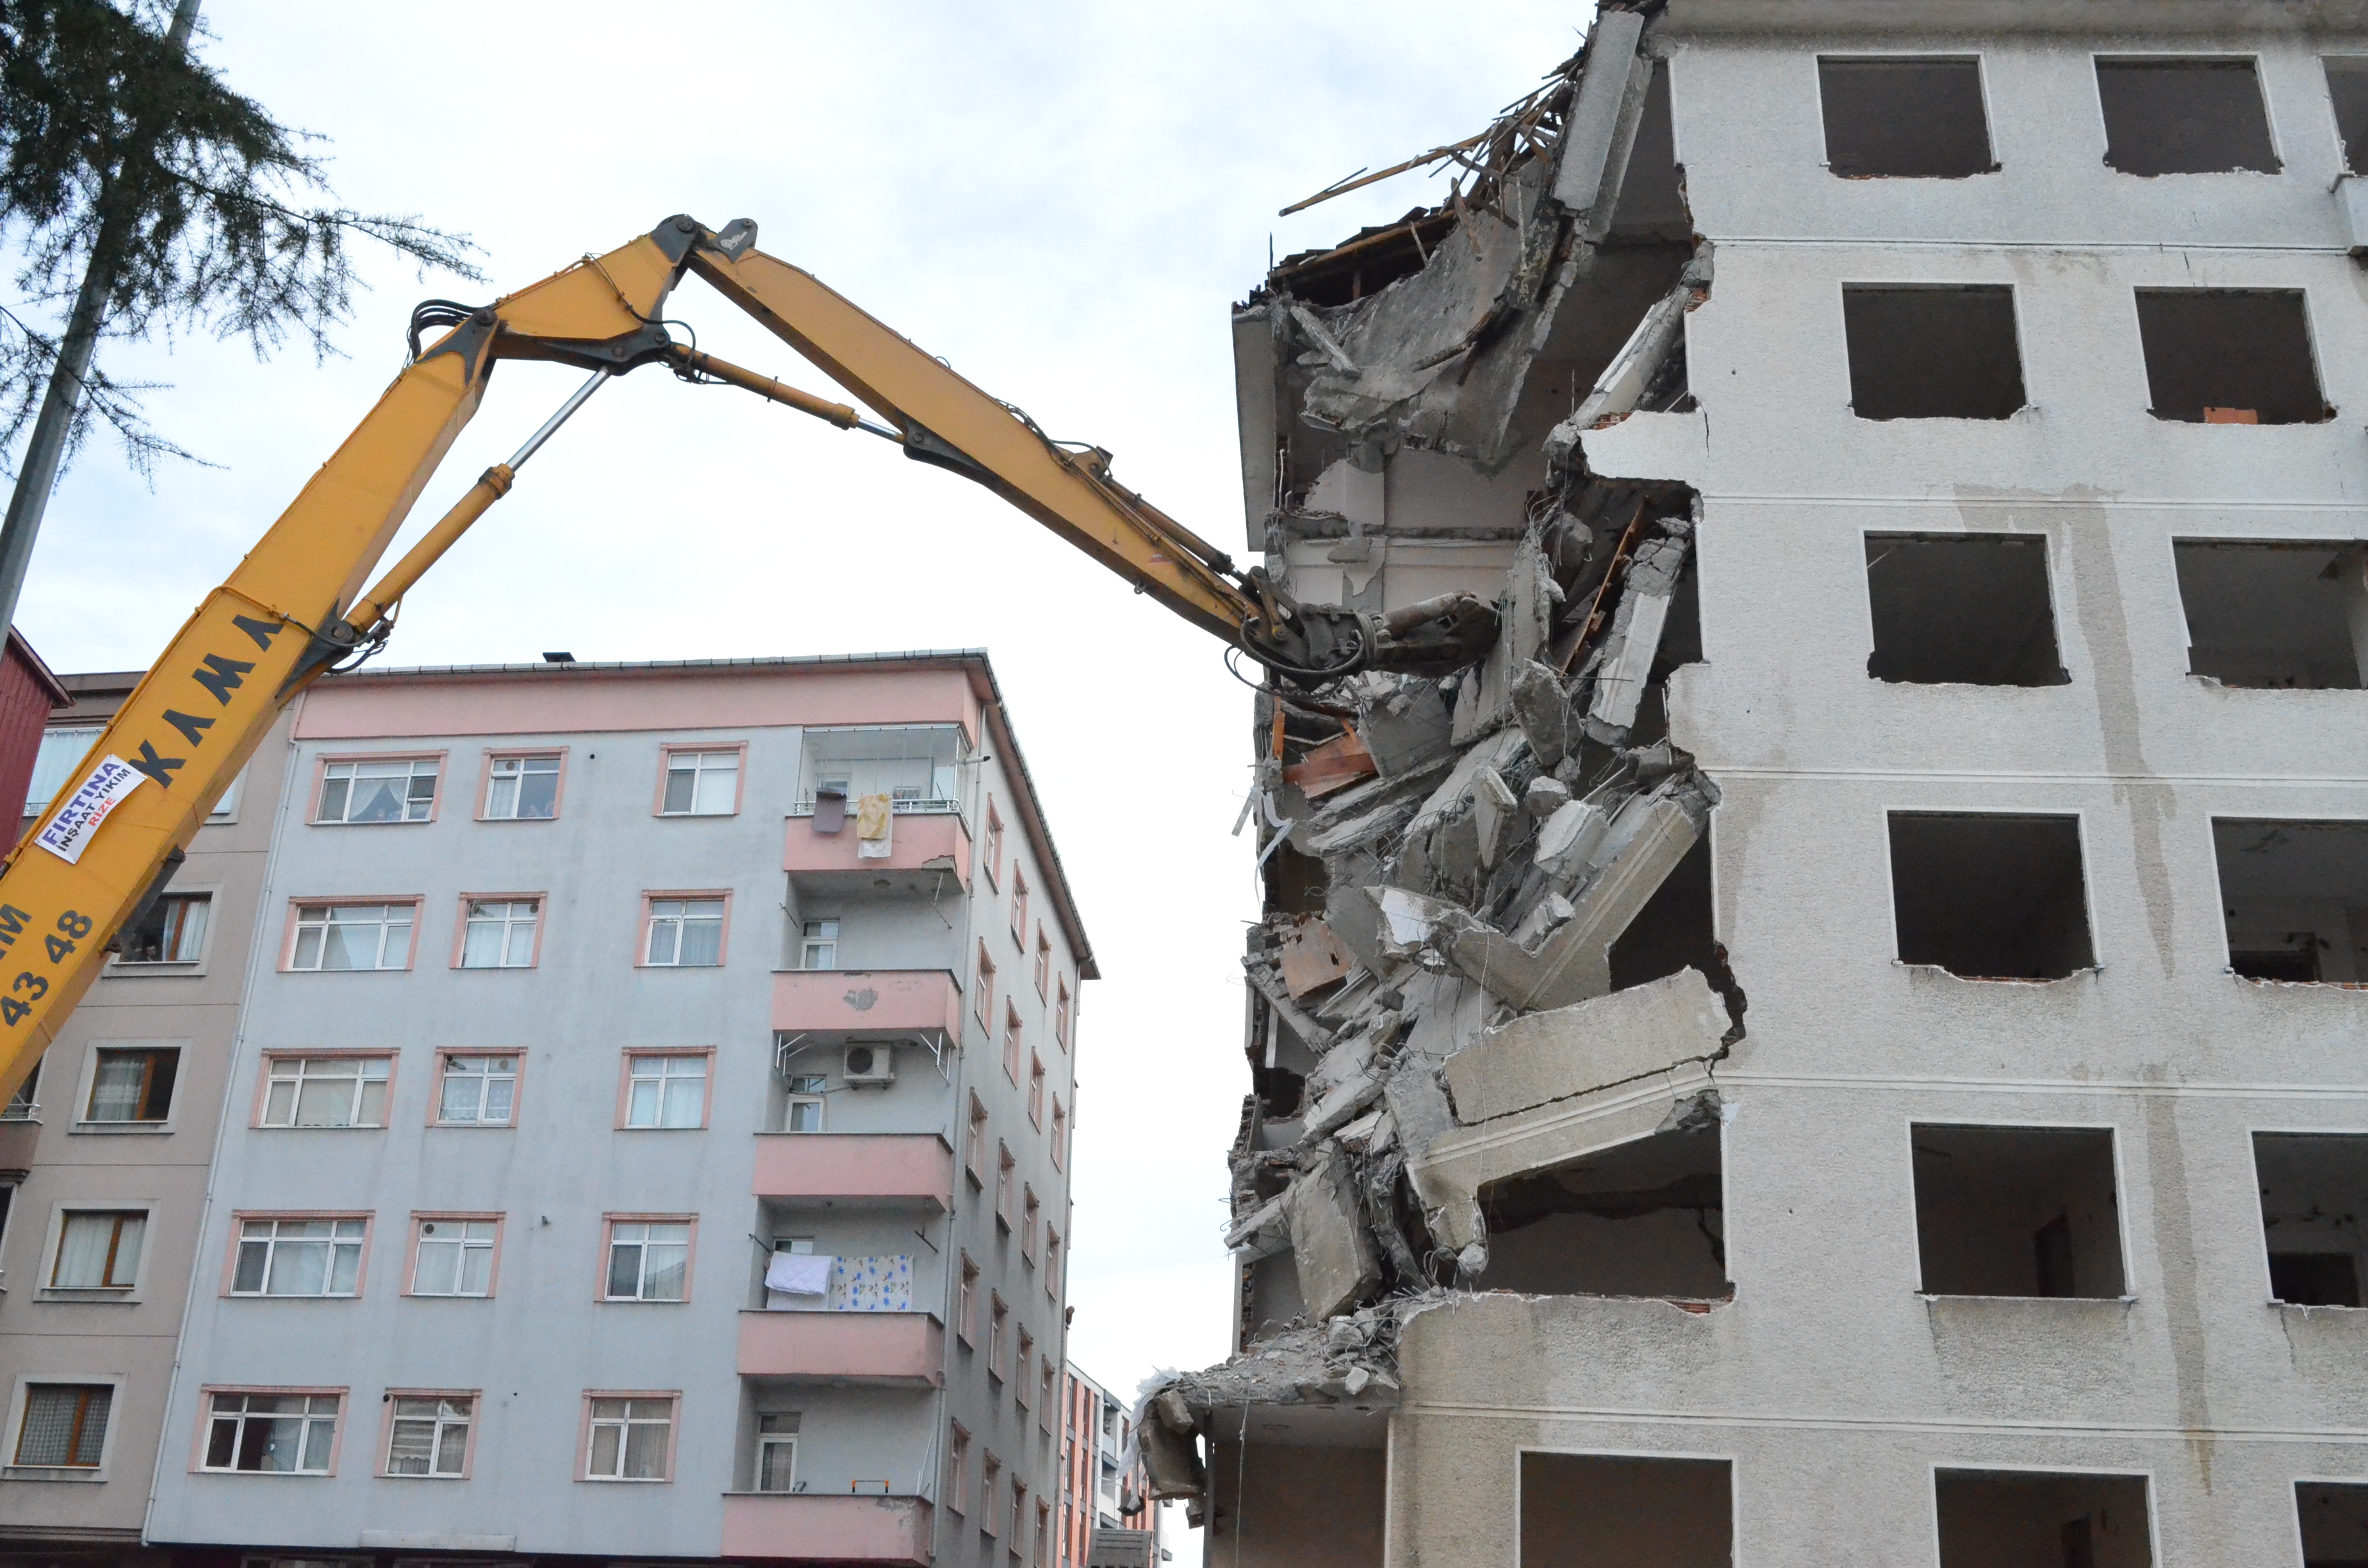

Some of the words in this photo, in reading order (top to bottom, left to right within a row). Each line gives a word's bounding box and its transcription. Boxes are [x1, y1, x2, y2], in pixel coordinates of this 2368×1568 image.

[128, 614, 284, 788] KAMA
[42, 763, 120, 845] FIRTINA
[56, 803, 95, 852] İNŞAAT
[94, 768, 131, 799] YIKIM
[88, 797, 116, 826] RİZE
[0, 972, 49, 1027] 43
[44, 910, 93, 964] 48
